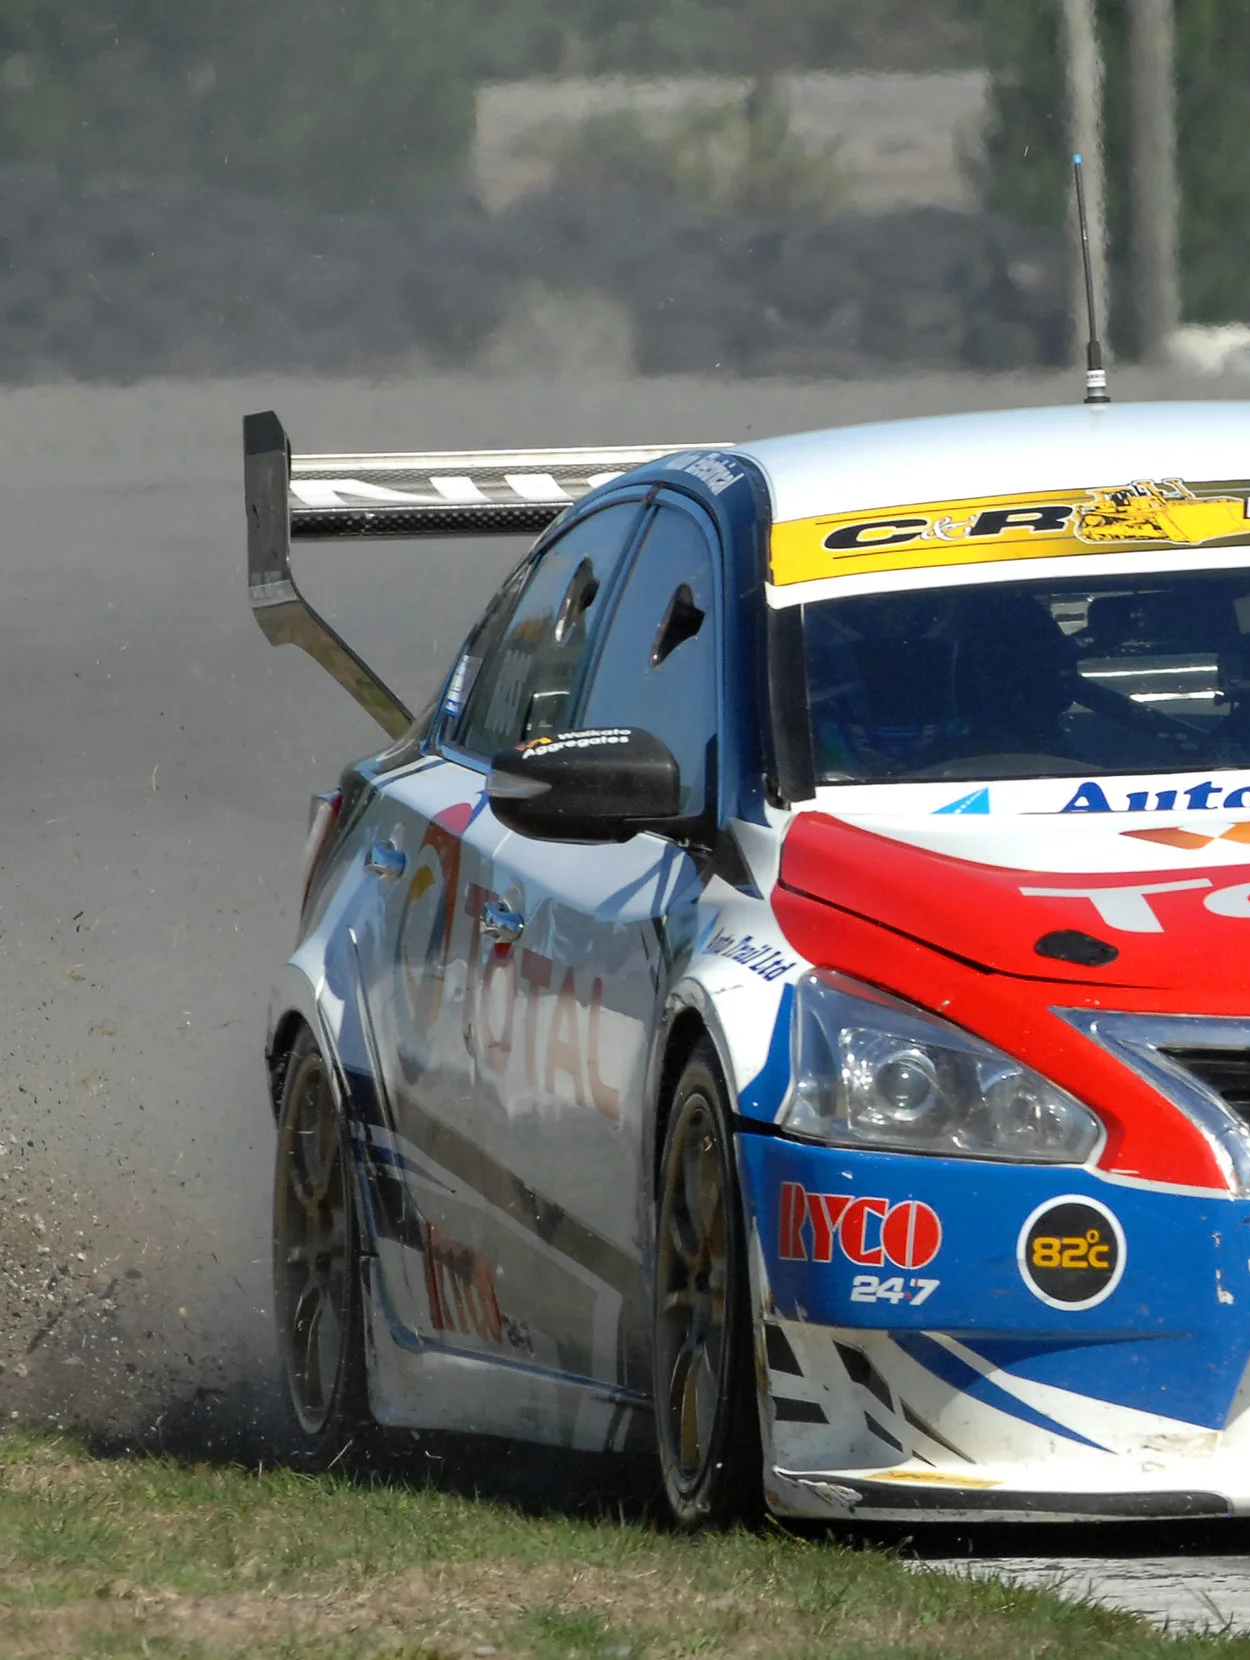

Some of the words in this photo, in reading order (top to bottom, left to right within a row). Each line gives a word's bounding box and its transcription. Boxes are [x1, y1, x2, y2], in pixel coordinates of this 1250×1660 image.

[824, 505, 1075, 550] C&R
[522, 736, 630, 760] Aggregates
[557, 728, 632, 741] Waikato
[747, 951, 798, 982] Ltd
[778, 1181, 943, 1270] RYCO
